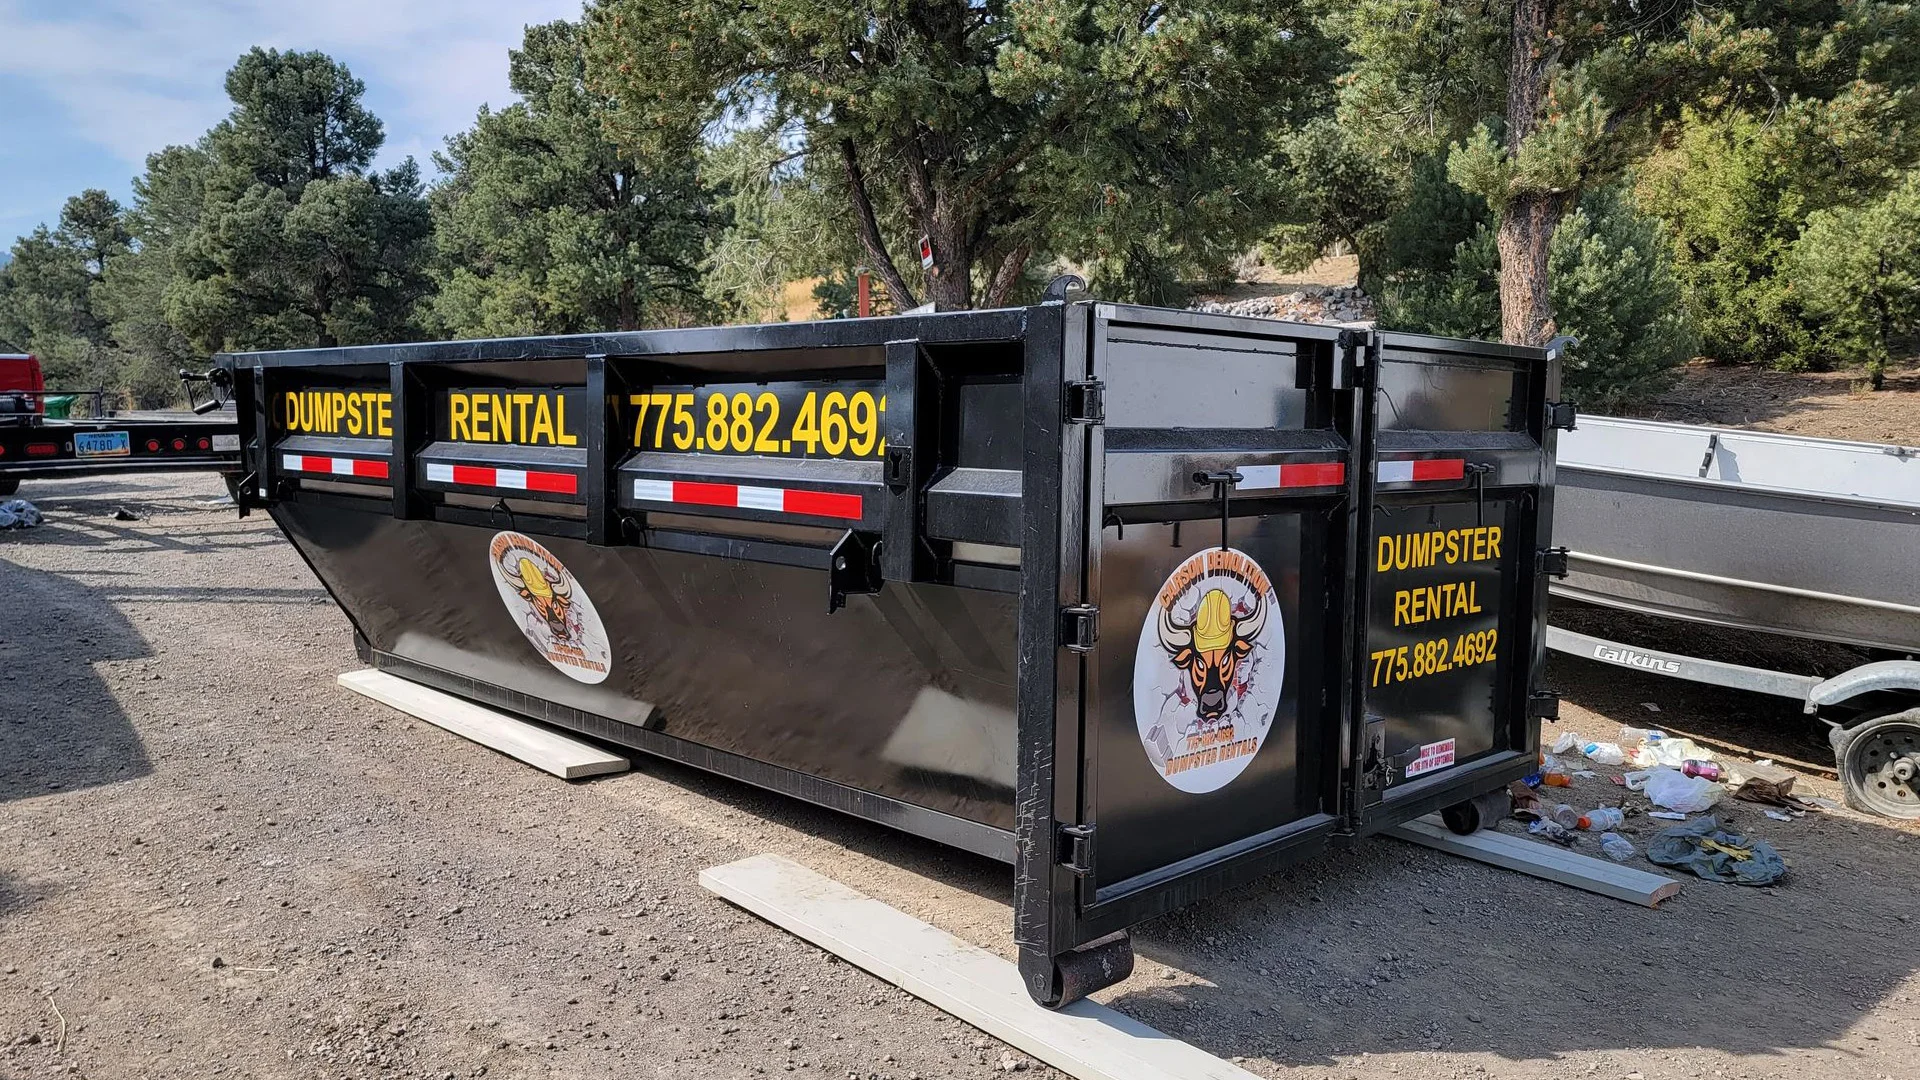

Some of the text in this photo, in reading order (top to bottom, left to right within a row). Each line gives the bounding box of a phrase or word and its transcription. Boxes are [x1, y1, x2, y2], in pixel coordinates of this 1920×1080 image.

[286, 391, 886, 457] DUMPSTE RENTAL 775.882.469
[1377, 526, 1502, 573] DUMPSTER
[1159, 551, 1270, 612] CARSON DEMOLITION
[1394, 580, 1482, 627] RENTAL
[1371, 628, 1498, 688] 775.882.4692
[1593, 644, 1681, 673] Calkins
[1165, 736, 1258, 776] DUMPSTER RENTALS
